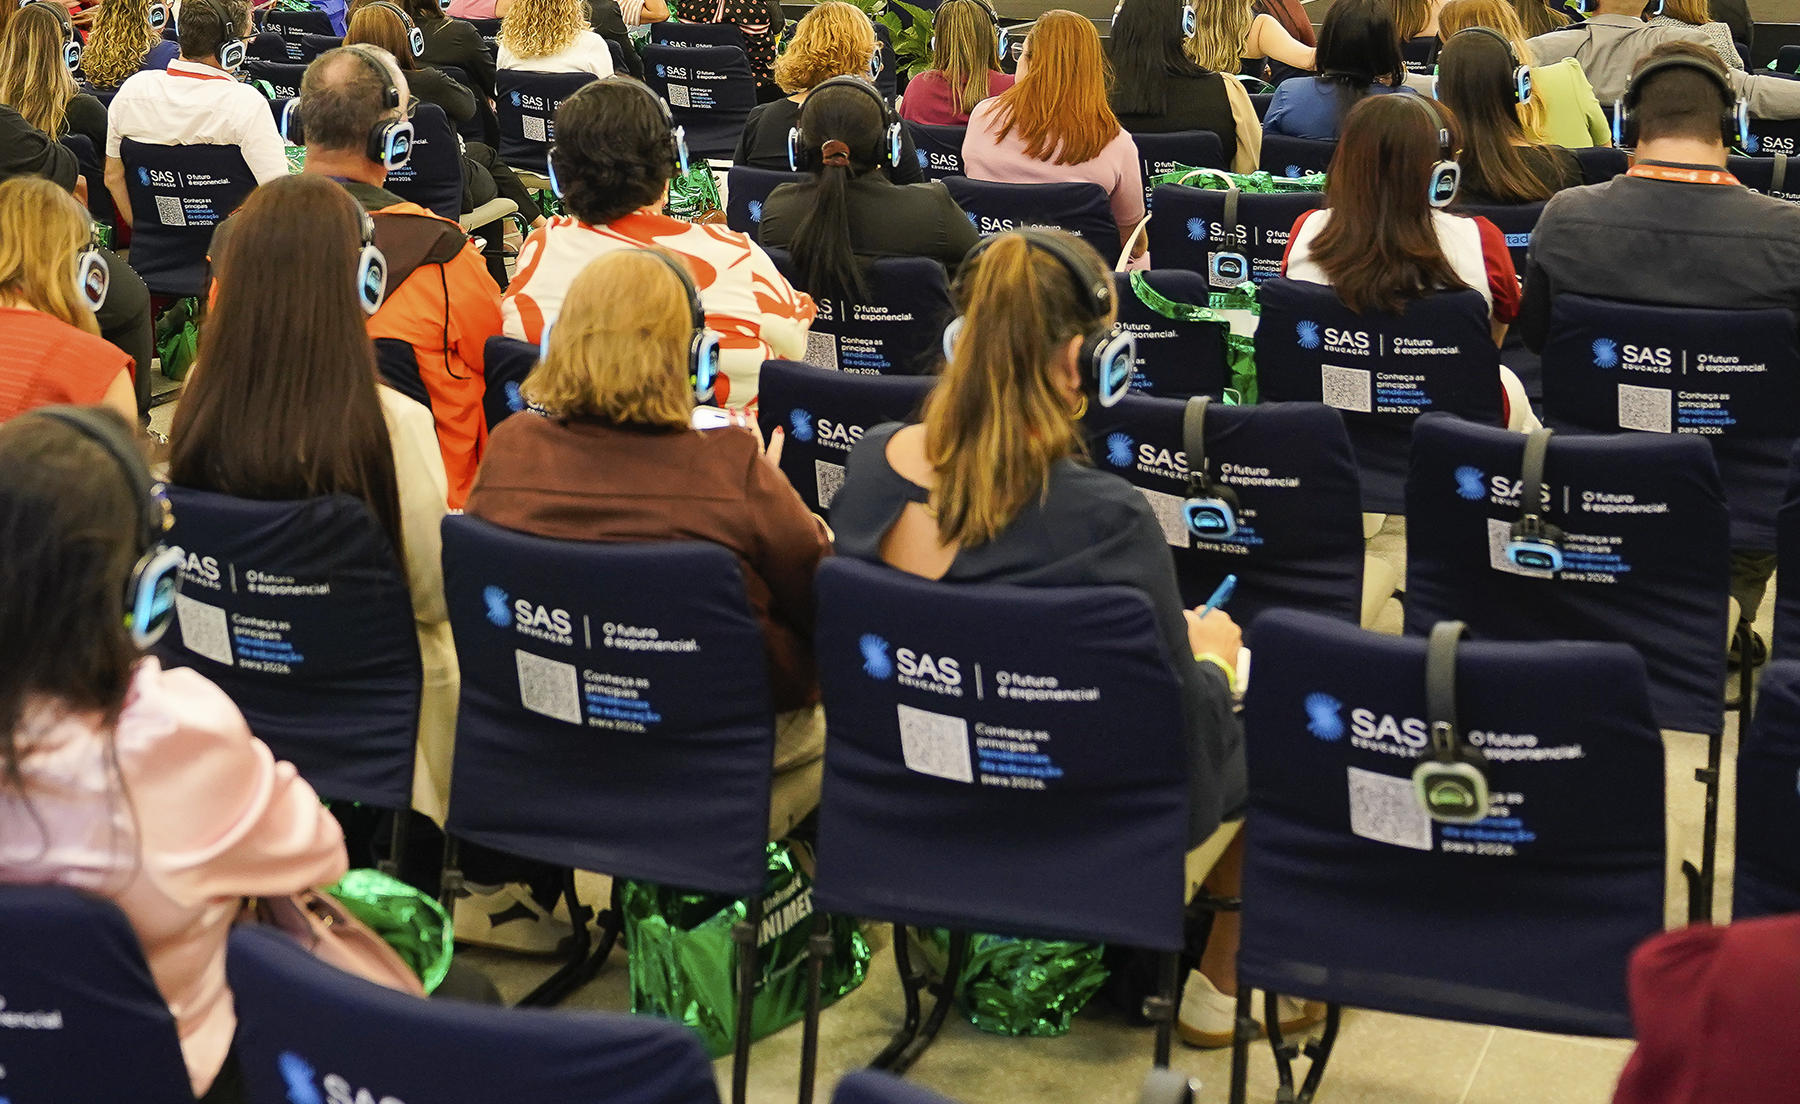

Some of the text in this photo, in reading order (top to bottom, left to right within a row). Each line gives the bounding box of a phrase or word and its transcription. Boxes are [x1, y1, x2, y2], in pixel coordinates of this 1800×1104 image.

[266, 23, 281, 32] SAS
[666, 65, 686, 75] SAS
[276, 85, 295, 95] SAS
[522, 94, 542, 106] SAS
[1762, 136, 1795, 150] SAS
[930, 153, 958, 167] SAS
[150, 170, 174, 182] SAS
[981, 216, 1013, 232] SAS
[853, 304, 888, 313] O futuro
[854, 312, 914, 322] é exponencial.
[1113, 321, 1151, 331] O futuro
[840, 336, 874, 345] Conheça
[1324, 328, 1370, 349] SAS
[1393, 337, 1433, 347] O futuro
[841, 344, 876, 353] principais
[1324, 345, 1370, 356] EDUCAÇÃO
[1394, 346, 1460, 356] é exponencial.
[842, 351, 883, 359] tendências
[1622, 344, 1672, 366] SAS
[1697, 353, 1739, 363] O futuro
[853, 359, 891, 368] educação
[1622, 363, 1672, 374] EDUCAÇÃO
[1697, 363, 1768, 373] é exponencial.
[860, 368, 881, 376] 2026.
[1377, 372, 1426, 383] Conheça as
[1377, 381, 1417, 390] principais
[1377, 396, 1433, 406] da educação
[1678, 391, 1719, 401] Conheça
[1377, 406, 1421, 414] para 2026.
[1678, 401, 1721, 409] principais
[1678, 408, 1729, 416] tendências
[1678, 416, 1736, 426] da educação
[817, 418, 864, 445] SAS
[1699, 426, 1724, 434] 2026.
[1138, 443, 1189, 473] SAS
[1221, 462, 1270, 477] O futuro
[1220, 474, 1229, 484] é
[1582, 490, 1635, 504] O futuro
[1582, 501, 1670, 514] é exponencial.
[246, 569, 258, 583] O
[515, 598, 572, 635] SAS
[603, 621, 659, 640] O futuro
[896, 647, 962, 686] SAS
[583, 668, 634, 688] Conheça
[996, 670, 1058, 689] O futuro
[975, 722, 1033, 740] Conheça
[1351, 708, 1428, 747] SAS
[1469, 729, 1539, 747] O futuro
